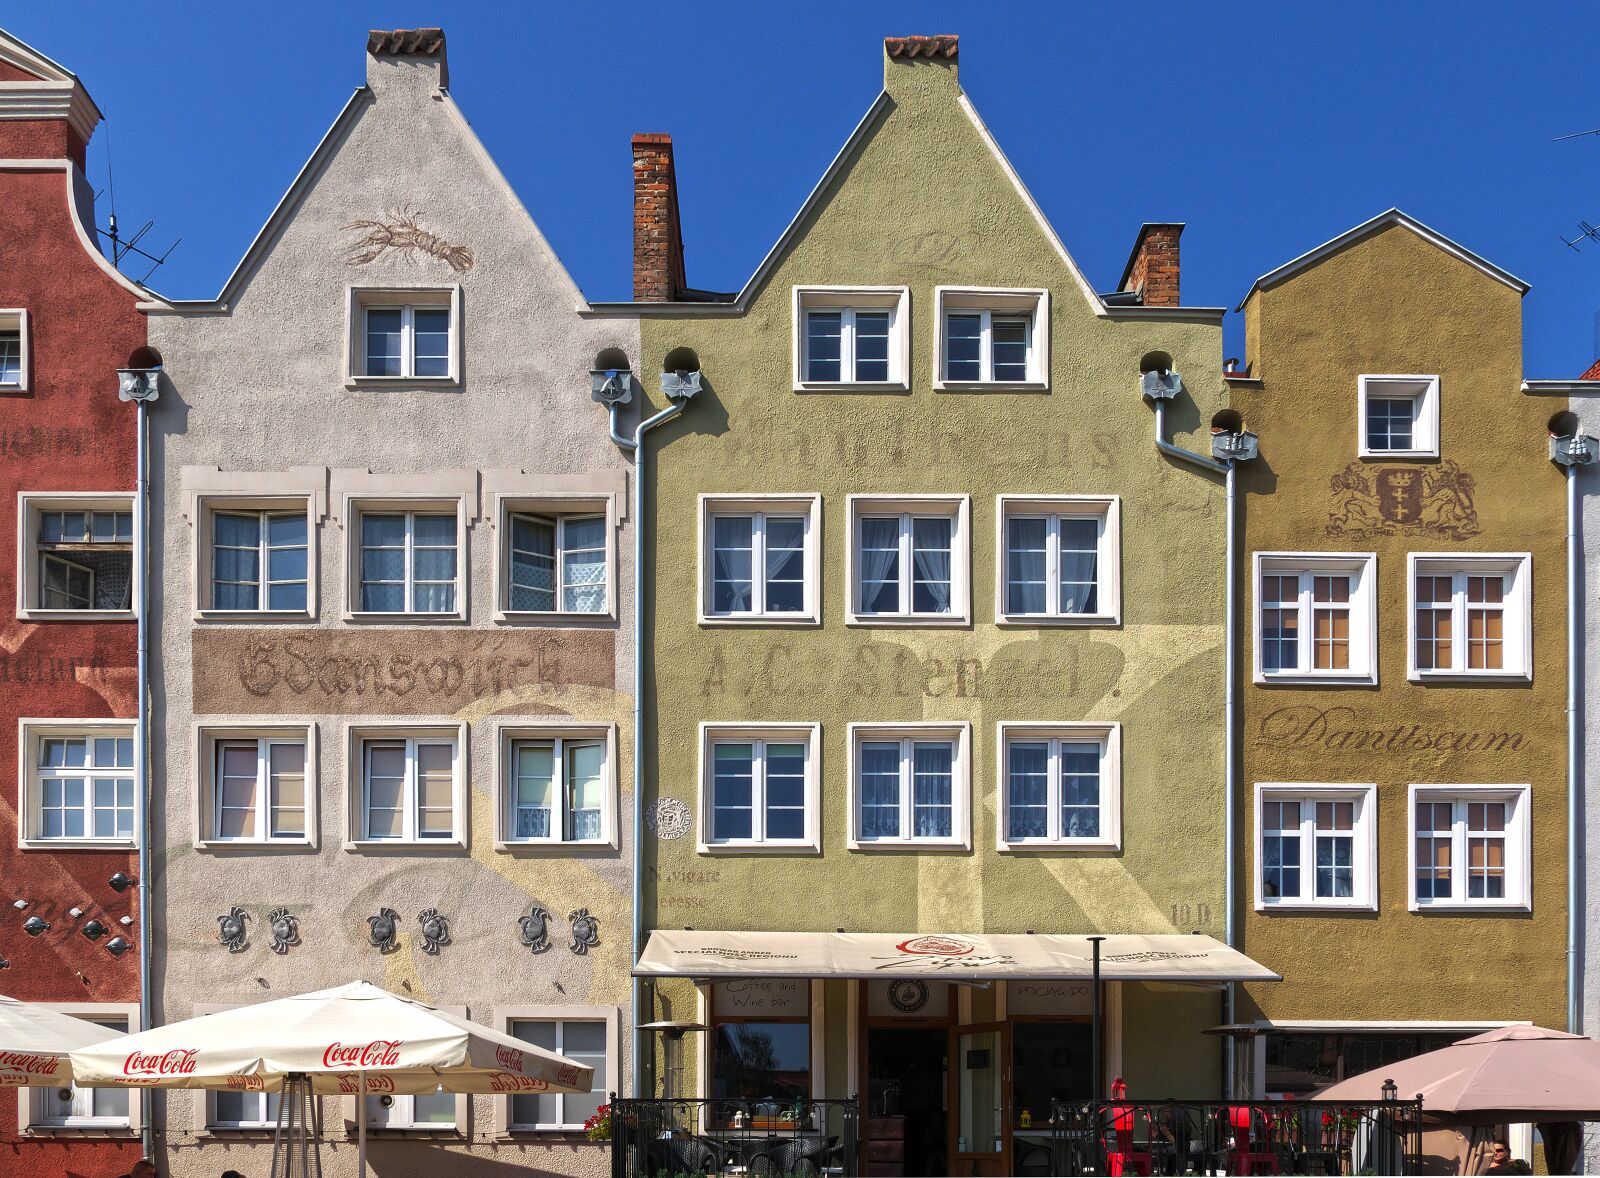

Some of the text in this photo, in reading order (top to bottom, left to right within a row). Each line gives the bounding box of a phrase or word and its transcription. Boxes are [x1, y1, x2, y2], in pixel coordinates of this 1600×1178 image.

[726, 978, 797, 993] Coffee and
[733, 993, 790, 1008] Wine bar
[123, 1049, 201, 1075] Coca-Cola
[323, 1040, 404, 1068] Coca-Cola
